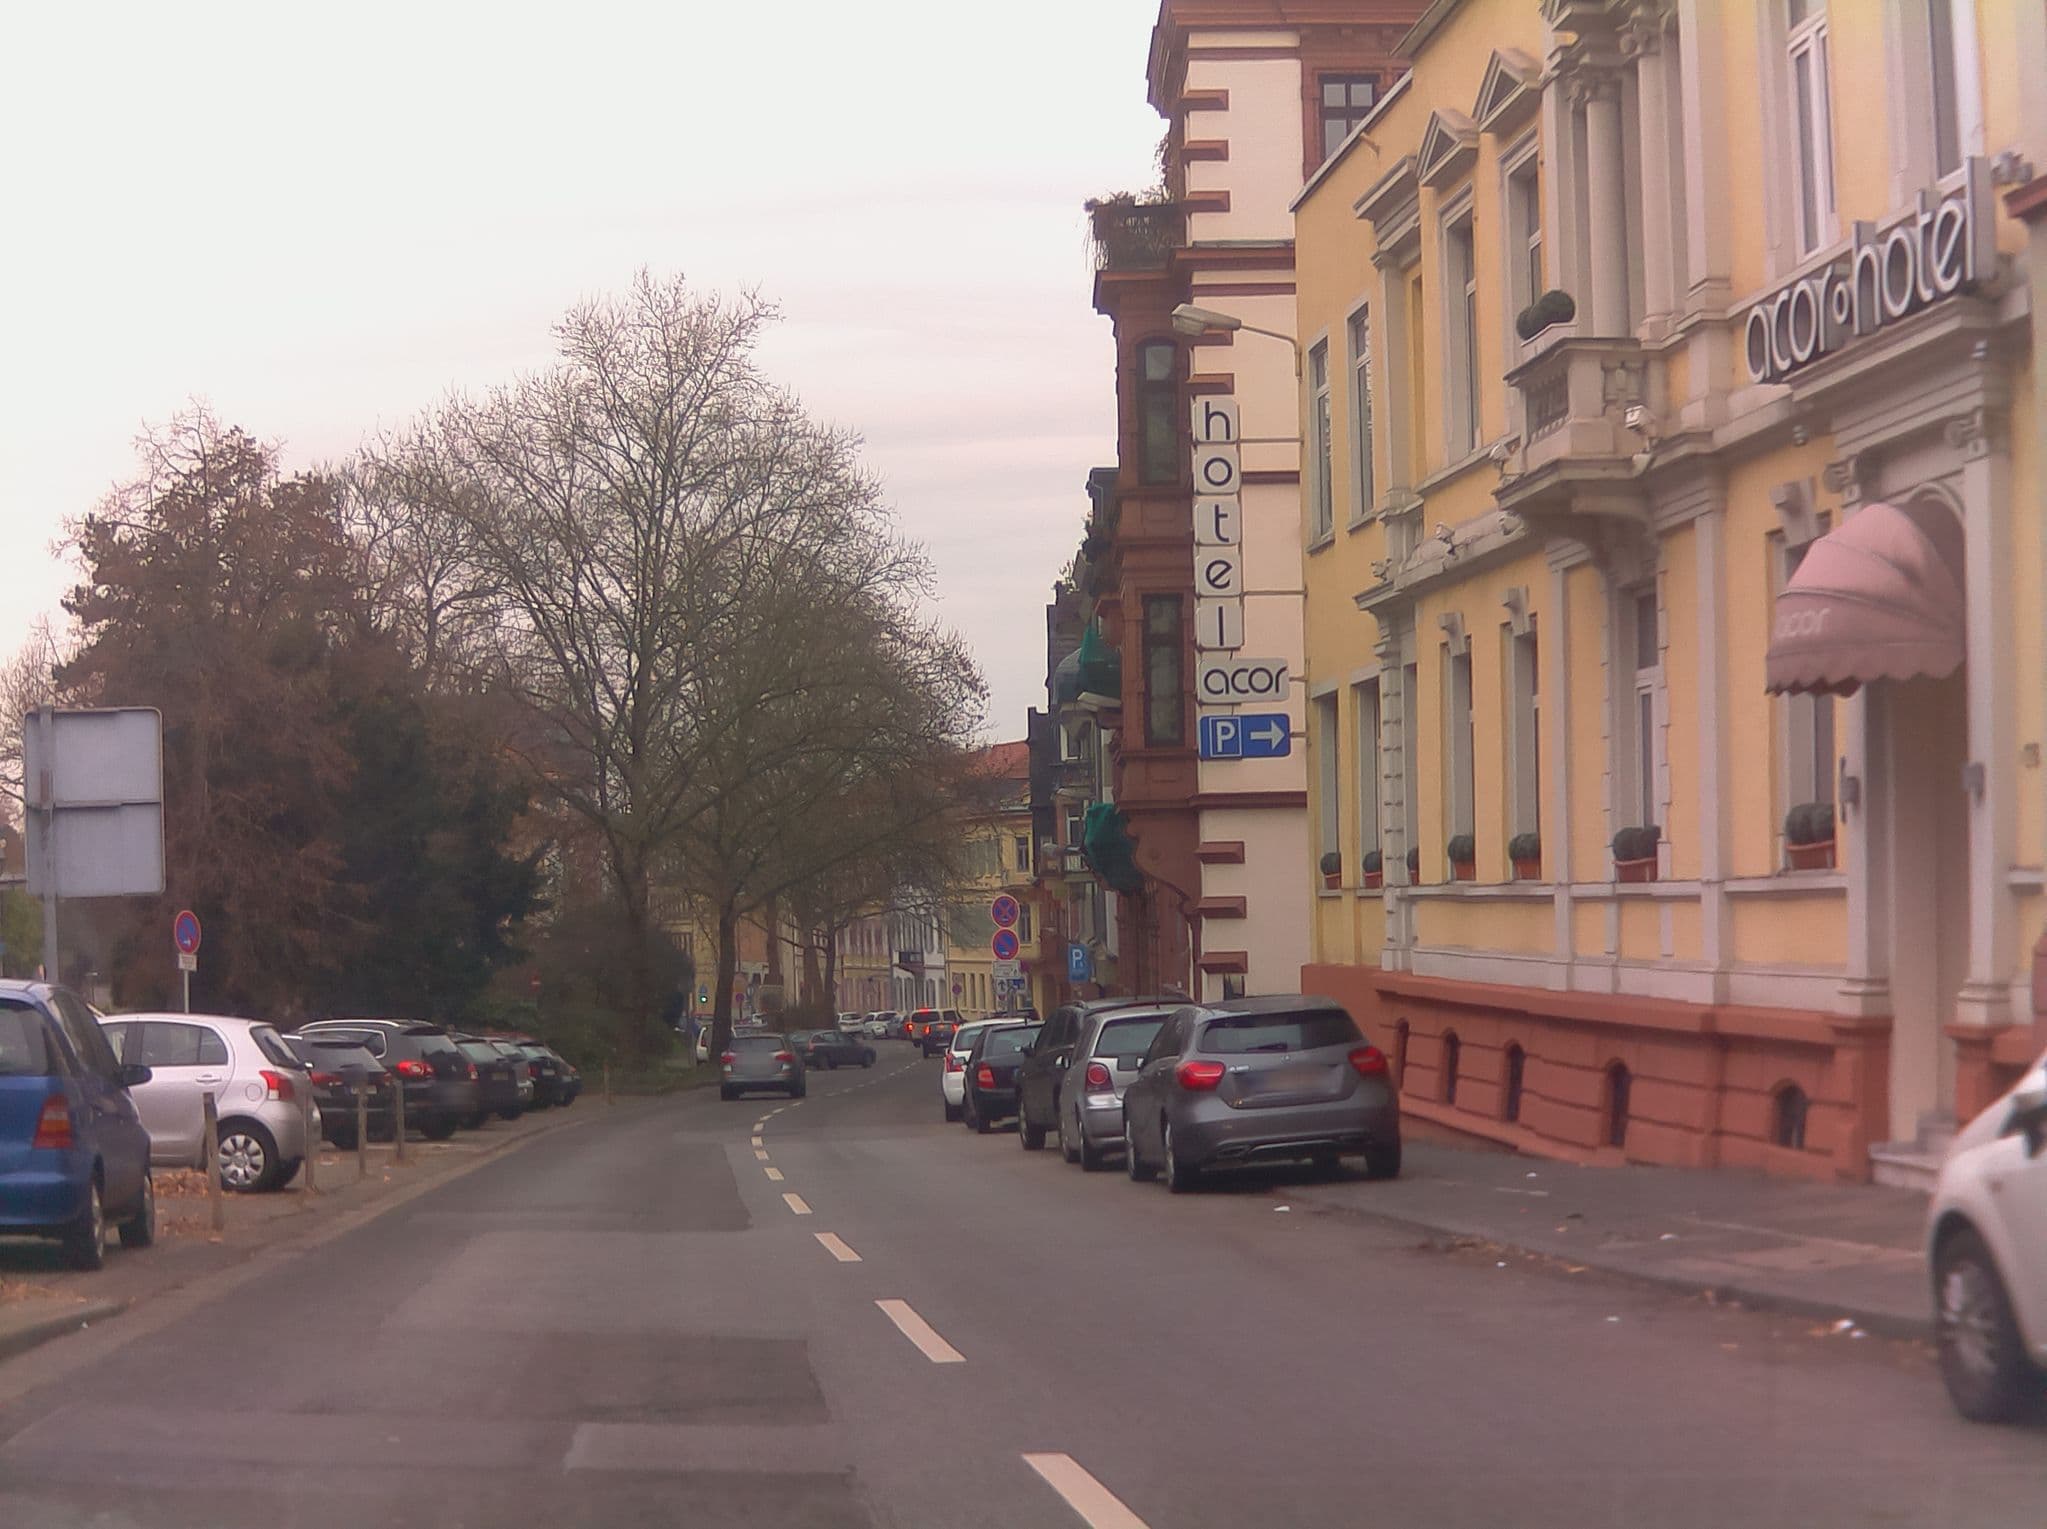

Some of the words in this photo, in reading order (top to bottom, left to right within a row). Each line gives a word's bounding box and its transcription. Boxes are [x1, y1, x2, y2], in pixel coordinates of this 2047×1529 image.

[1745, 264, 1833, 383] acor
[1852, 155, 1976, 336] hotel
[1203, 400, 1234, 647] hotel
[1203, 665, 1288, 695] acor
[1215, 720, 1237, 753] P
